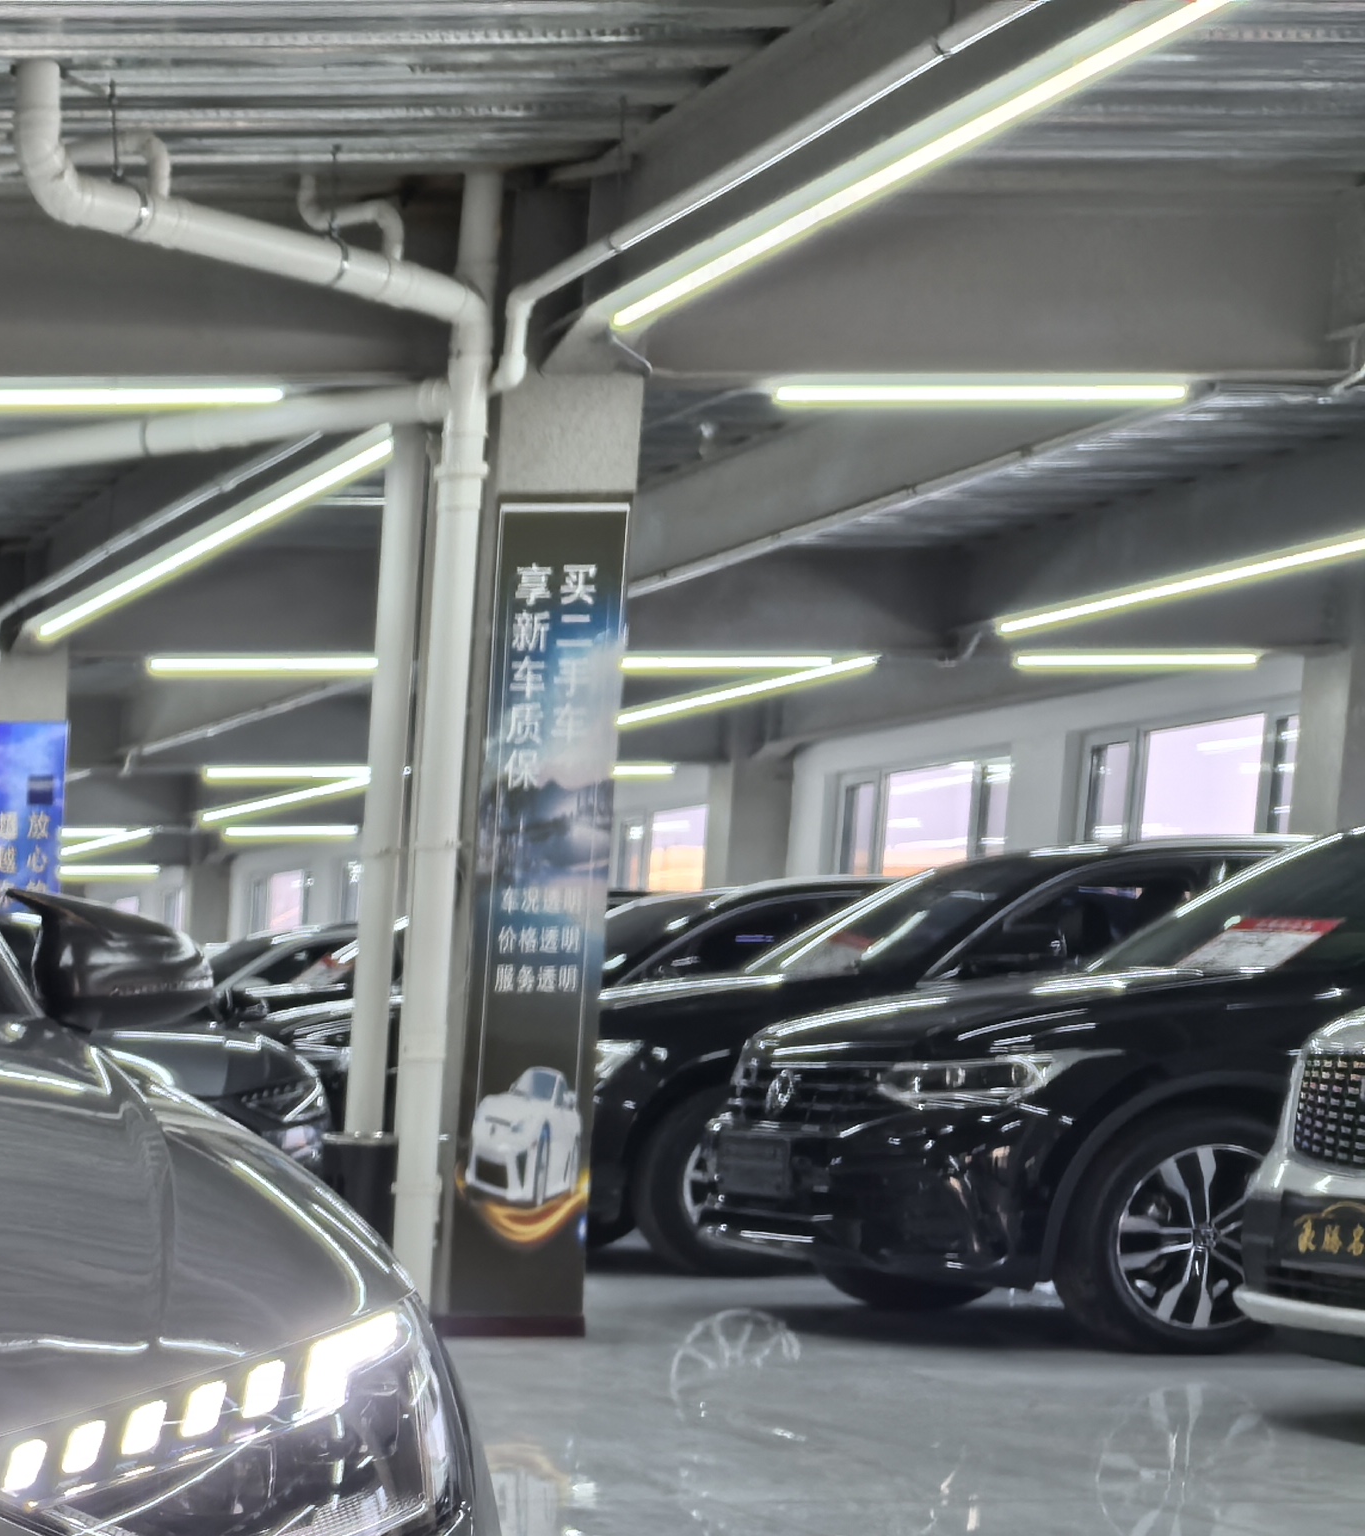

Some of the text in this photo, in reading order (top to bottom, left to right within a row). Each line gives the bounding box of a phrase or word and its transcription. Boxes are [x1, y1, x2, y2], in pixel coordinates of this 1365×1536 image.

[555, 565, 597, 743] 买二手车
[504, 563, 551, 792] 享新车质保
[501, 886, 582, 914] 车况透明
[498, 925, 581, 954] 价格透明
[495, 964, 578, 992] 服务透明
